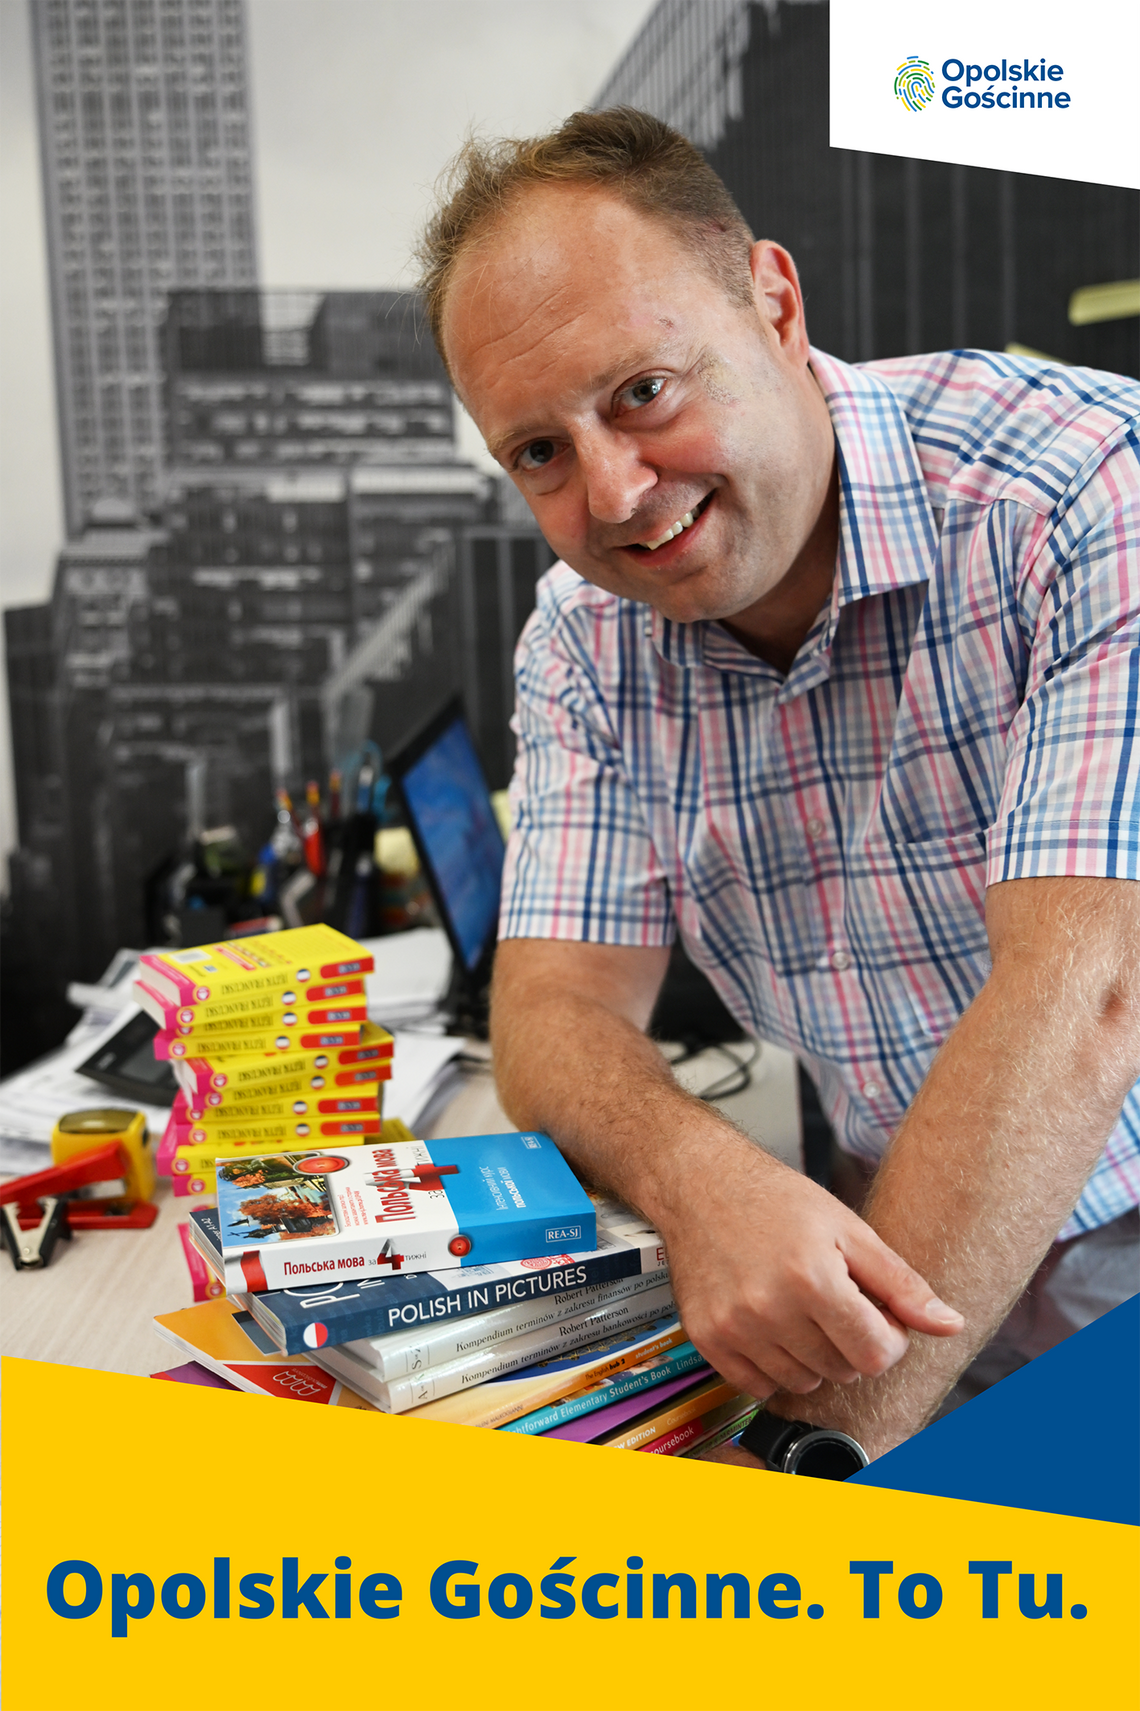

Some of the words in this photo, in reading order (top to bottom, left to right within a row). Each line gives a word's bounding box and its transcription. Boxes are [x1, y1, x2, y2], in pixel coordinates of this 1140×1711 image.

[406, 1145, 430, 1166] ижні
[548, 1228, 579, 1240] REA-SJ
[283, 1259, 336, 1276] Польська
[337, 1256, 365, 1269] мова
[377, 1238, 405, 1271] 4
[405, 1252, 427, 1262] тижні
[388, 1294, 461, 1327] POLISH
[468, 1288, 489, 1309] IN
[495, 1266, 587, 1303] PICTURES
[554, 1290, 583, 1305] Robert
[456, 1327, 514, 1352] Kompendium
[515, 1312, 555, 1332] terminów
[564, 1299, 596, 1315] zakresu
[597, 1287, 633, 1302] finansów
[634, 1281, 644, 1291] po
[559, 1320, 588, 1336] Robert
[590, 1307, 629, 1326] Patterson
[461, 1358, 519, 1384] Kompendium
[521, 1344, 560, 1363] terminów
[569, 1328, 601, 1345] zakresu
[602, 1310, 648, 1333] bankowości
[650, 1308, 660, 1318] po
[635, 1345, 660, 1360] student's
[659, 1338, 673, 1348] book
[585, 1372, 595, 1380] The
[595, 1366, 609, 1379] English
[609, 1361, 620, 1371] hub
[511, 1410, 559, 1434] htforward
[560, 1393, 607, 1418] Elementary
[609, 1376, 649, 1398] Student's
[650, 1366, 672, 1381] Book
[676, 1354, 705, 1371] Lindsa
[666, 1407, 696, 1426] Coursebook
[626, 1426, 656, 1447] EDITION
